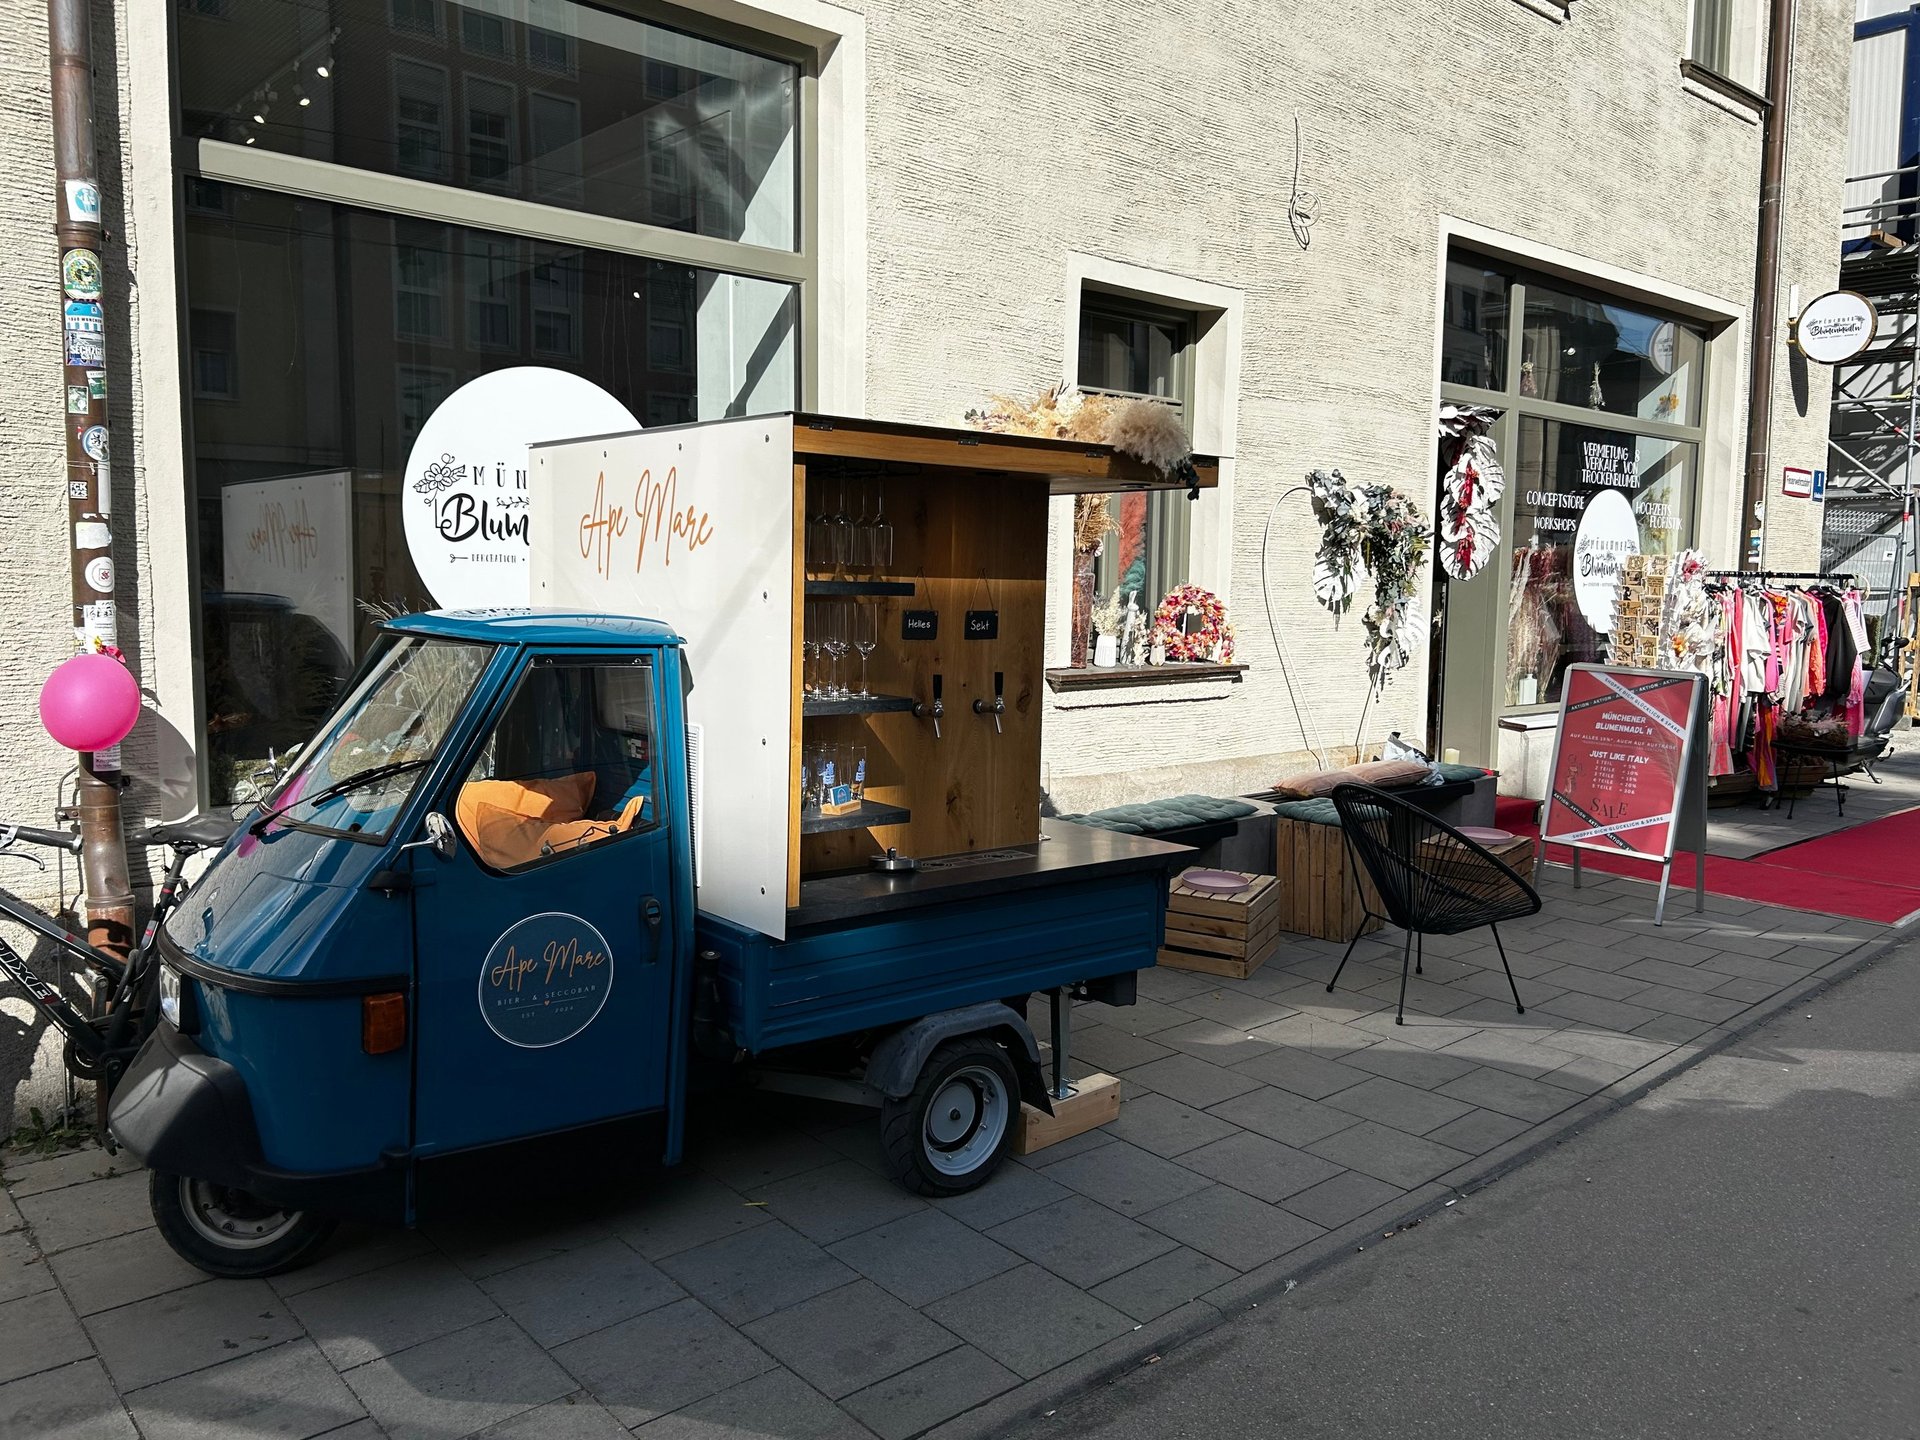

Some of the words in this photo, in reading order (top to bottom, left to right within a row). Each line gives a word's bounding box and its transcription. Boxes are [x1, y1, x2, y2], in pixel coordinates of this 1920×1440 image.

[1583, 441, 1629, 461] VERMIETUNG
[1585, 455, 1619, 473] VERKAUF
[1623, 460, 1639, 475] VON
[1581, 469, 1640, 488] TROCKENBLUMEN
[579, 471, 628, 580] Ape
[634, 466, 714, 574] Mare
[1534, 516, 1576, 532] WORKSHOPS
[907, 618, 931, 629] Helles
[970, 619, 990, 631] Sekt
[1571, 702, 1590, 711] AKTION
[1593, 695, 1611, 705] AKTION
[1639, 683, 1659, 692] AKTION
[1604, 677, 1622, 692] SHOPPE
[1622, 690, 1635, 700] DICH
[1634, 699, 1661, 719] GLÜCKLICH
[1664, 719, 1681, 733] SPARE
[1602, 711, 1646, 724] MÜNCHENER
[1589, 750, 1608, 759] JUST
[1609, 752, 1625, 761] LIKE
[1627, 755, 1649, 764] ITALY
[1553, 793, 1569, 807] AKTION
[1570, 806, 1586, 820] AKTION
[1590, 798, 1628, 818] SALE
[1572, 831, 1593, 839] SHOPPE
[1608, 820, 1640, 831] GLÜCKLICH
[1645, 816, 1664, 824] SPARE
[491, 945, 538, 992] Ape
[543, 937, 606, 985] Mare
[544, 984, 596, 998] SECCOBAR
